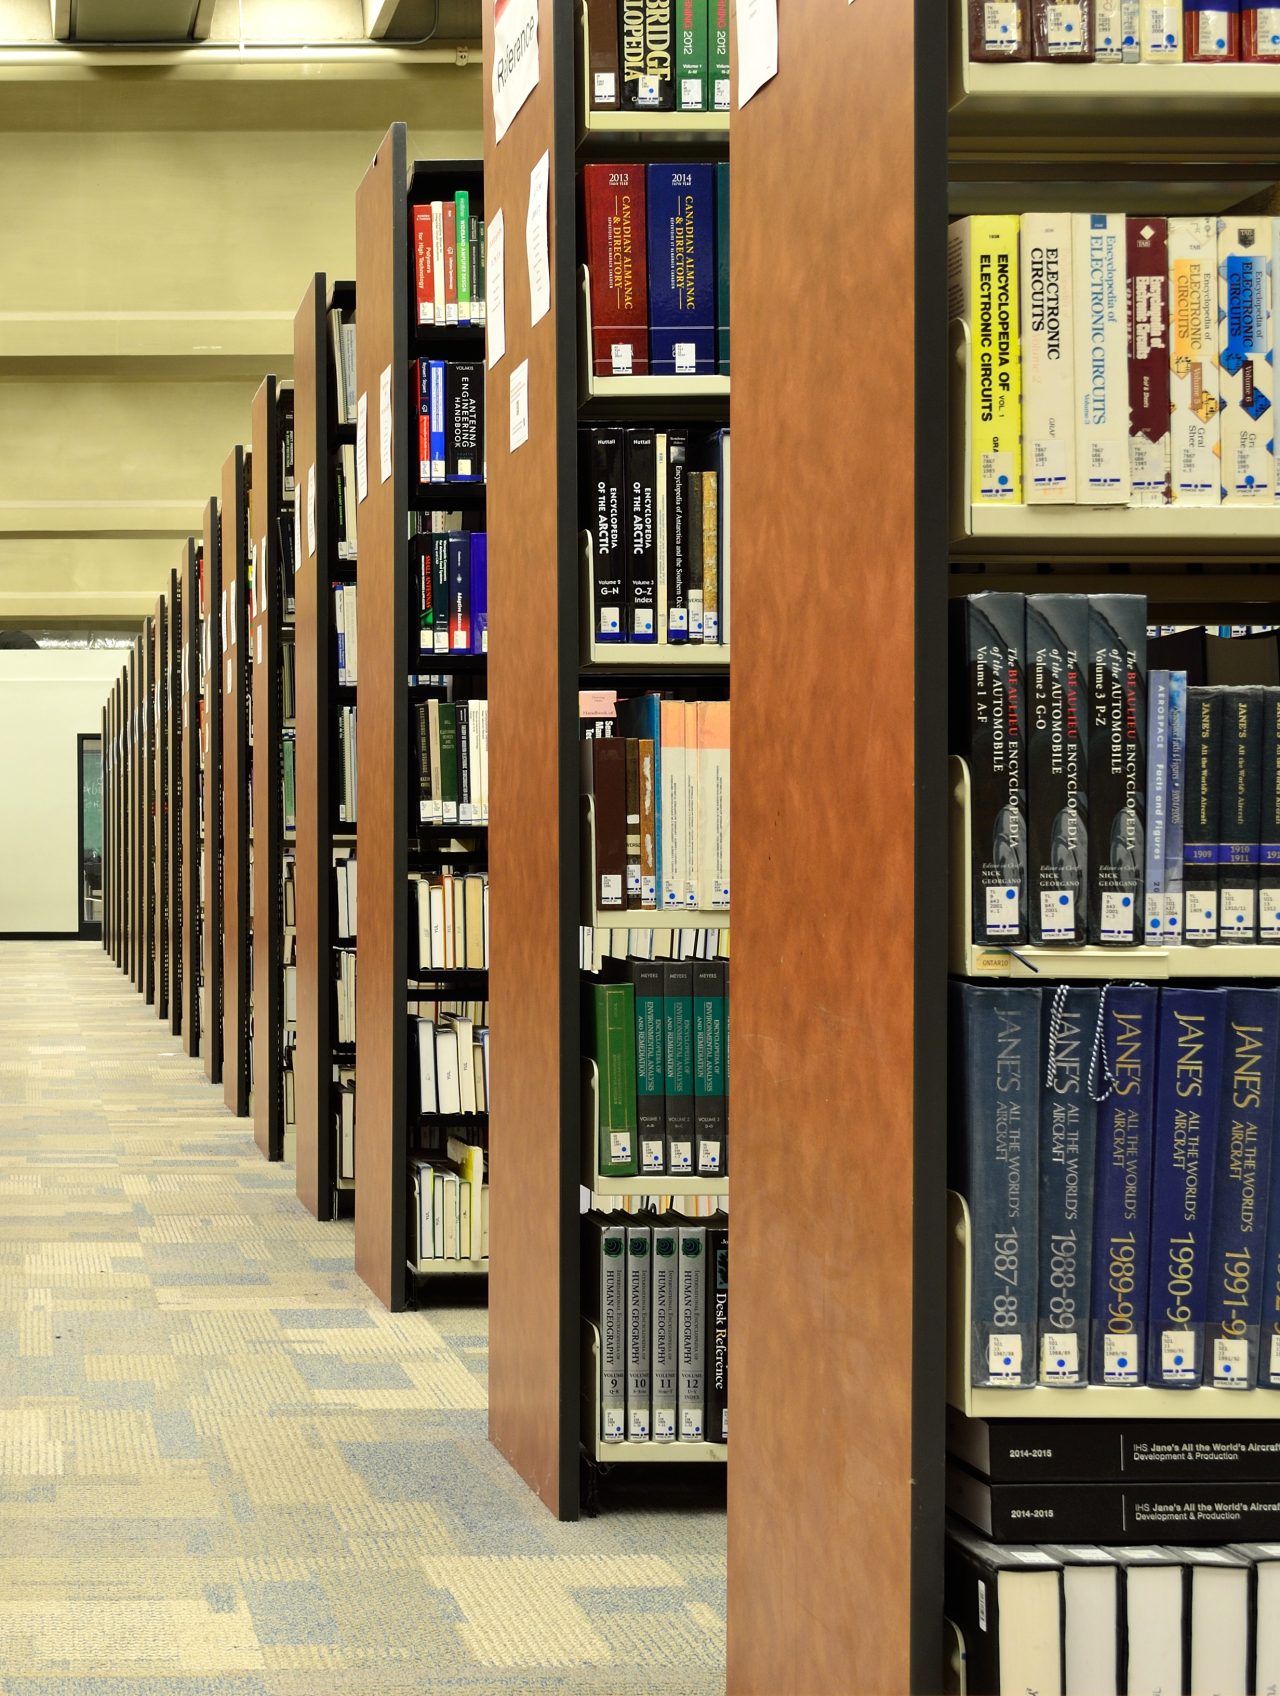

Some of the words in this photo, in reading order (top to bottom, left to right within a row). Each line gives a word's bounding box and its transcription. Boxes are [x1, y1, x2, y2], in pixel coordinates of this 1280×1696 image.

[497, 15, 535, 93] Reference
[683, 31, 693, 55] 2012
[608, 173, 629, 182] 2013
[671, 173, 692, 182] 2014
[612, 216, 621, 225] &
[622, 195, 632, 253] CANADIAN
[613, 227, 623, 289] DIRECTORY
[623, 256, 633, 310] ALMANAC
[980, 254, 992, 348] ELECTRONIC
[1031, 247, 1045, 332] CIRCUITS
[1255, 271, 1264, 327] Encyclopedia
[997, 254, 1010, 366] ENCYCLOPEDIA
[1046, 248, 1060, 360] ELECTRONIC
[1230, 273, 1241, 337] CIRCUITS
[1242, 262, 1253, 348] ELECTRONIC
[1256, 329, 1263, 338] of
[980, 352, 993, 422] CIRCUITS
[998, 372, 1010, 392] OF
[461, 376, 469, 448] ENGINEERING
[469, 398, 477, 448] ANTENNA
[633, 481, 641, 494] OF
[674, 465, 683, 505] Encyclopedia
[633, 497, 641, 512] THE
[644, 487, 652, 549] ENCYCLOPEDIA
[675, 506, 683, 514] of
[633, 514, 644, 555] ARCTIC
[675, 515, 683, 545] Antarctica
[675, 545, 683, 557] and
[675, 557, 683, 568] the
[675, 568, 683, 596] Southern
[1035, 648, 1047, 690] Volume
[1049, 648, 1062, 663] of
[1051, 661, 1063, 679] the
[1067, 650, 1077, 670] The
[1035, 704, 1047, 730] G-O
[1067, 672, 1078, 739] BEAULIEU
[1157, 684, 1165, 749] AEROSPACE
[1201, 702, 1211, 739] JANE'S
[1051, 682, 1063, 775] AUTOMOBILE
[1201, 744, 1209, 755] All
[1201, 757, 1209, 769] the
[1155, 764, 1164, 791] Facts
[1200, 769, 1209, 795] World's
[1067, 743, 1078, 850] ENCYCLOPEDIA
[1154, 795, 1163, 816] and
[1200, 796, 1208, 825] Aircraft
[1153, 820, 1163, 860] Figures
[1193, 850, 1212, 859] 1909
[705, 1001, 713, 1058] ENVIRONMENTAL
[993, 1006, 1022, 1092] JANE'S
[1173, 1010, 1206, 1097] JANE'S
[714, 1066, 720, 1074] OF
[1008, 1101, 1021, 1124] ALL
[1188, 1110, 1201, 1132] ALL
[995, 1101, 1008, 1162] AIRCRAFT
[1008, 1127, 1021, 1151] THE
[1173, 1108, 1188, 1170] AIRCRAFT
[1187, 1136, 1200, 1159] THE
[1008, 1155, 1020, 1218] WORLD'S
[1184, 1160, 1198, 1221] WORLD'S
[606, 1270, 615, 1307] HUMAN
[683, 1270, 692, 1307] HUMAN
[993, 1226, 1019, 1328] 1987-88
[1166, 1231, 1196, 1331] 1990-9
[716, 1293, 727, 1325] Desk
[606, 1308, 615, 1366] GEOGRAPHY
[683, 1308, 692, 1366] GEOGRAPHY
[715, 1327, 727, 1390] Reference
[610, 1379, 618, 1389] 9
[687, 1379, 699, 1389] 12
[1009, 1449, 1052, 1458] 2014-2015
[1133, 1443, 1148, 1452] IHS
[1150, 1443, 1180, 1452] Jane's
[1181, 1443, 1194, 1452] All
[1195, 1443, 1211, 1452] the
[1212, 1443, 1246, 1452] World's
[1133, 1452, 1185, 1462] Development
[1186, 1452, 1193, 1461] &
[1195, 1451, 1239, 1461] Production
